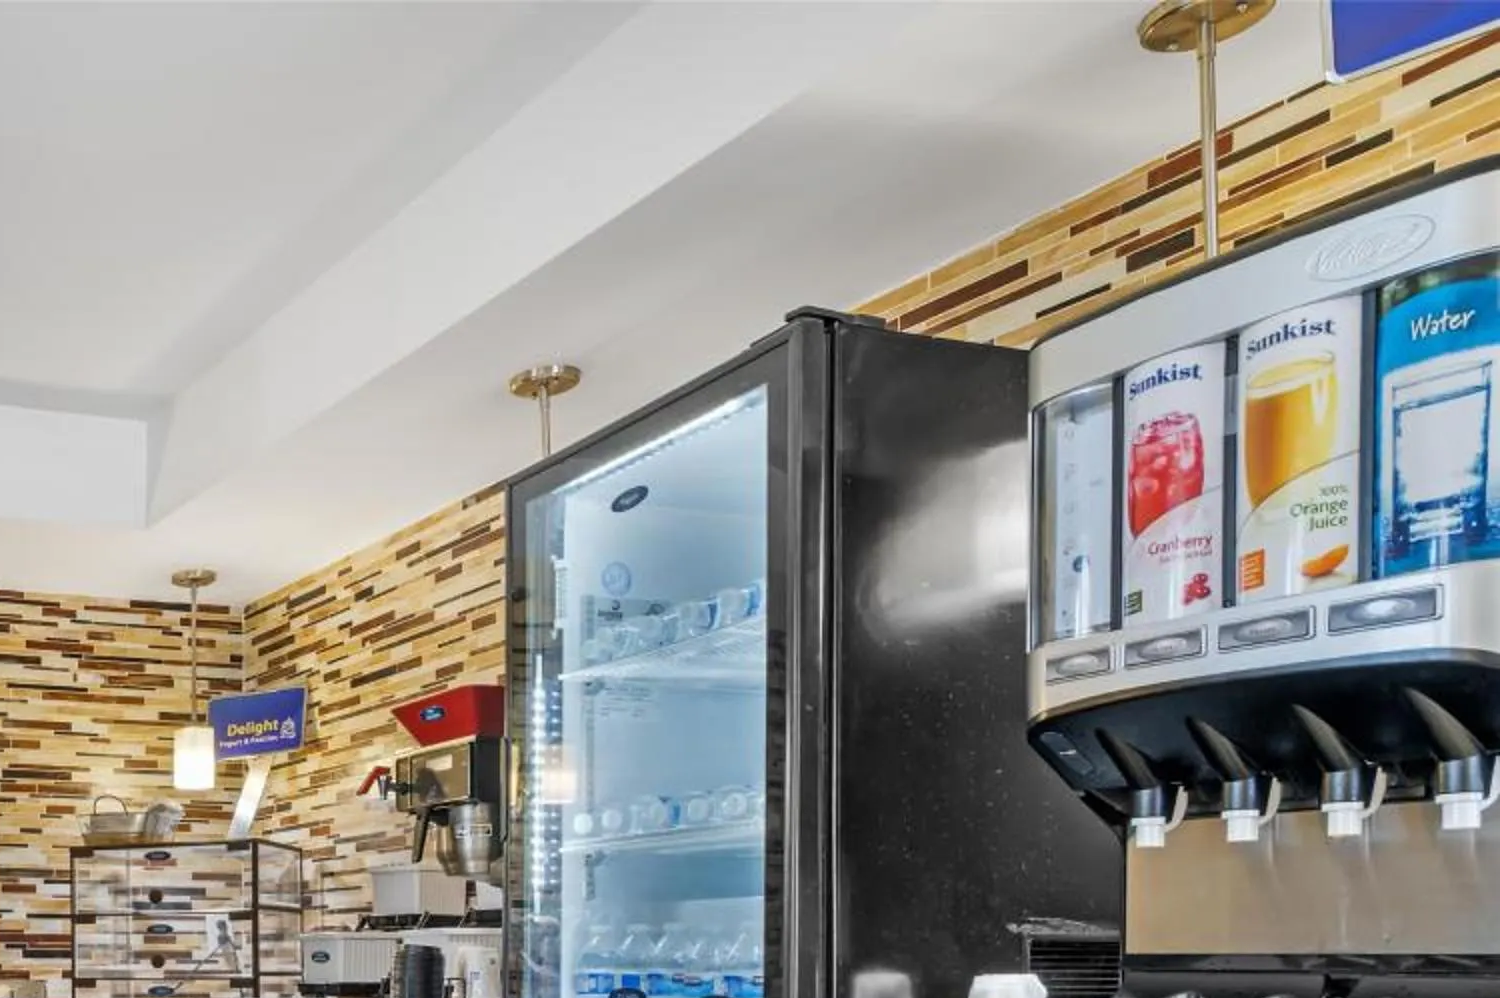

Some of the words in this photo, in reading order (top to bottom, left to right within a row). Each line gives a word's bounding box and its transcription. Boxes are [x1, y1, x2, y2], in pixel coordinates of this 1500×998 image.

[1411, 309, 1477, 341] Water
[1246, 318, 1336, 360] Sunkist
[1129, 363, 1203, 400] Sunkist
[1289, 499, 1348, 518] Orange
[1309, 515, 1348, 531] Juice
[227, 719, 279, 737] Delight
